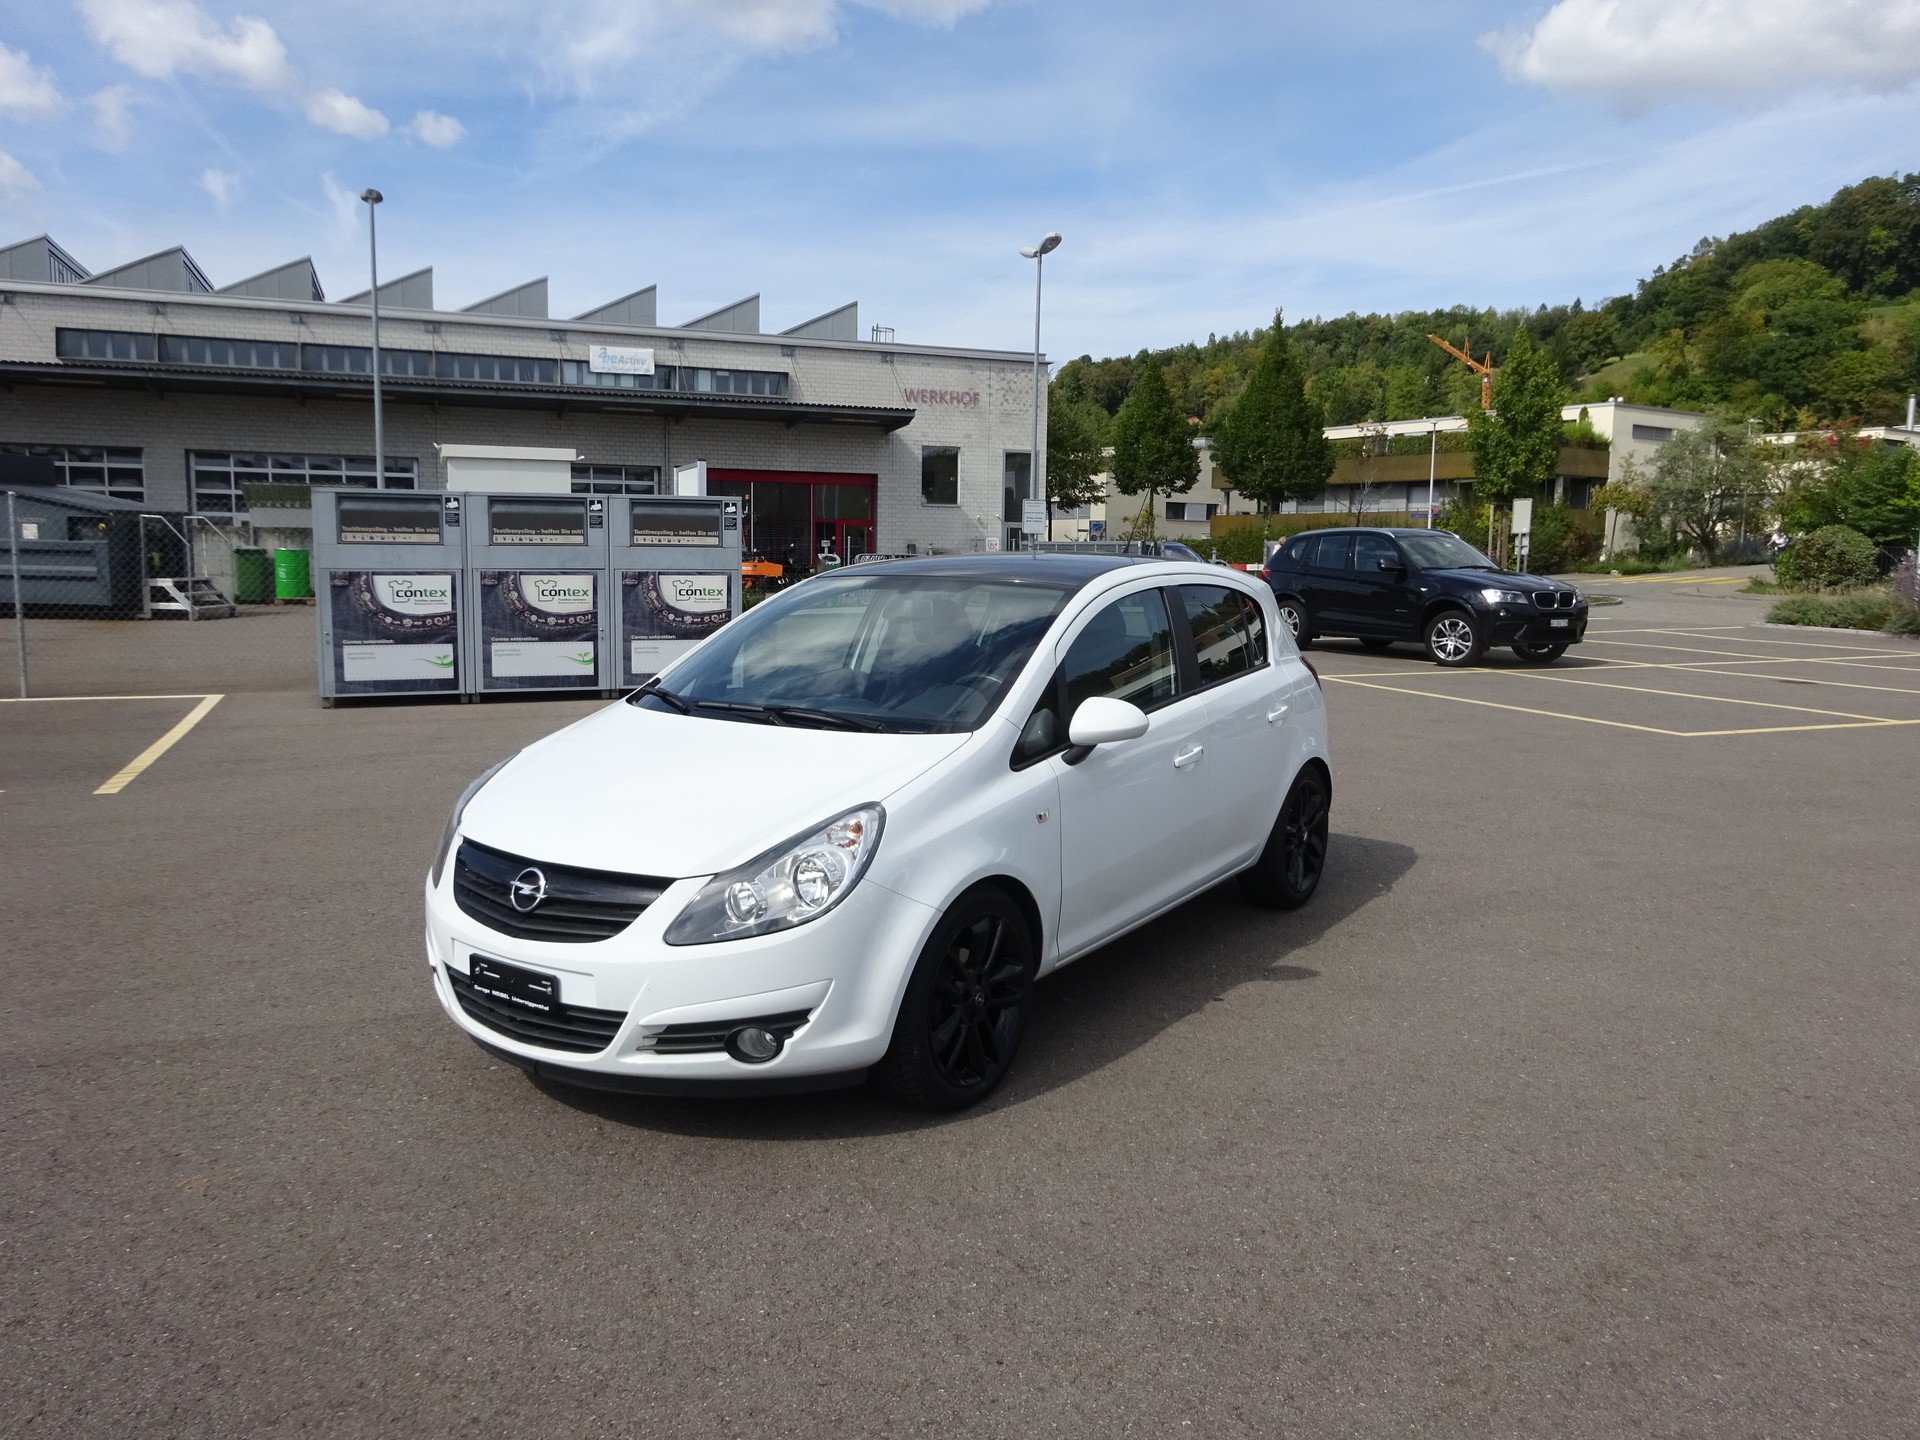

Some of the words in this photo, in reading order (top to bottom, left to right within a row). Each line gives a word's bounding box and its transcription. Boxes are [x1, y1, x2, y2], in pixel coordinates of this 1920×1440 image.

[904, 388, 980, 406] WERKHOF
[396, 588, 448, 598] contex
[541, 588, 590, 597] contex
[678, 587, 724, 597] contex
